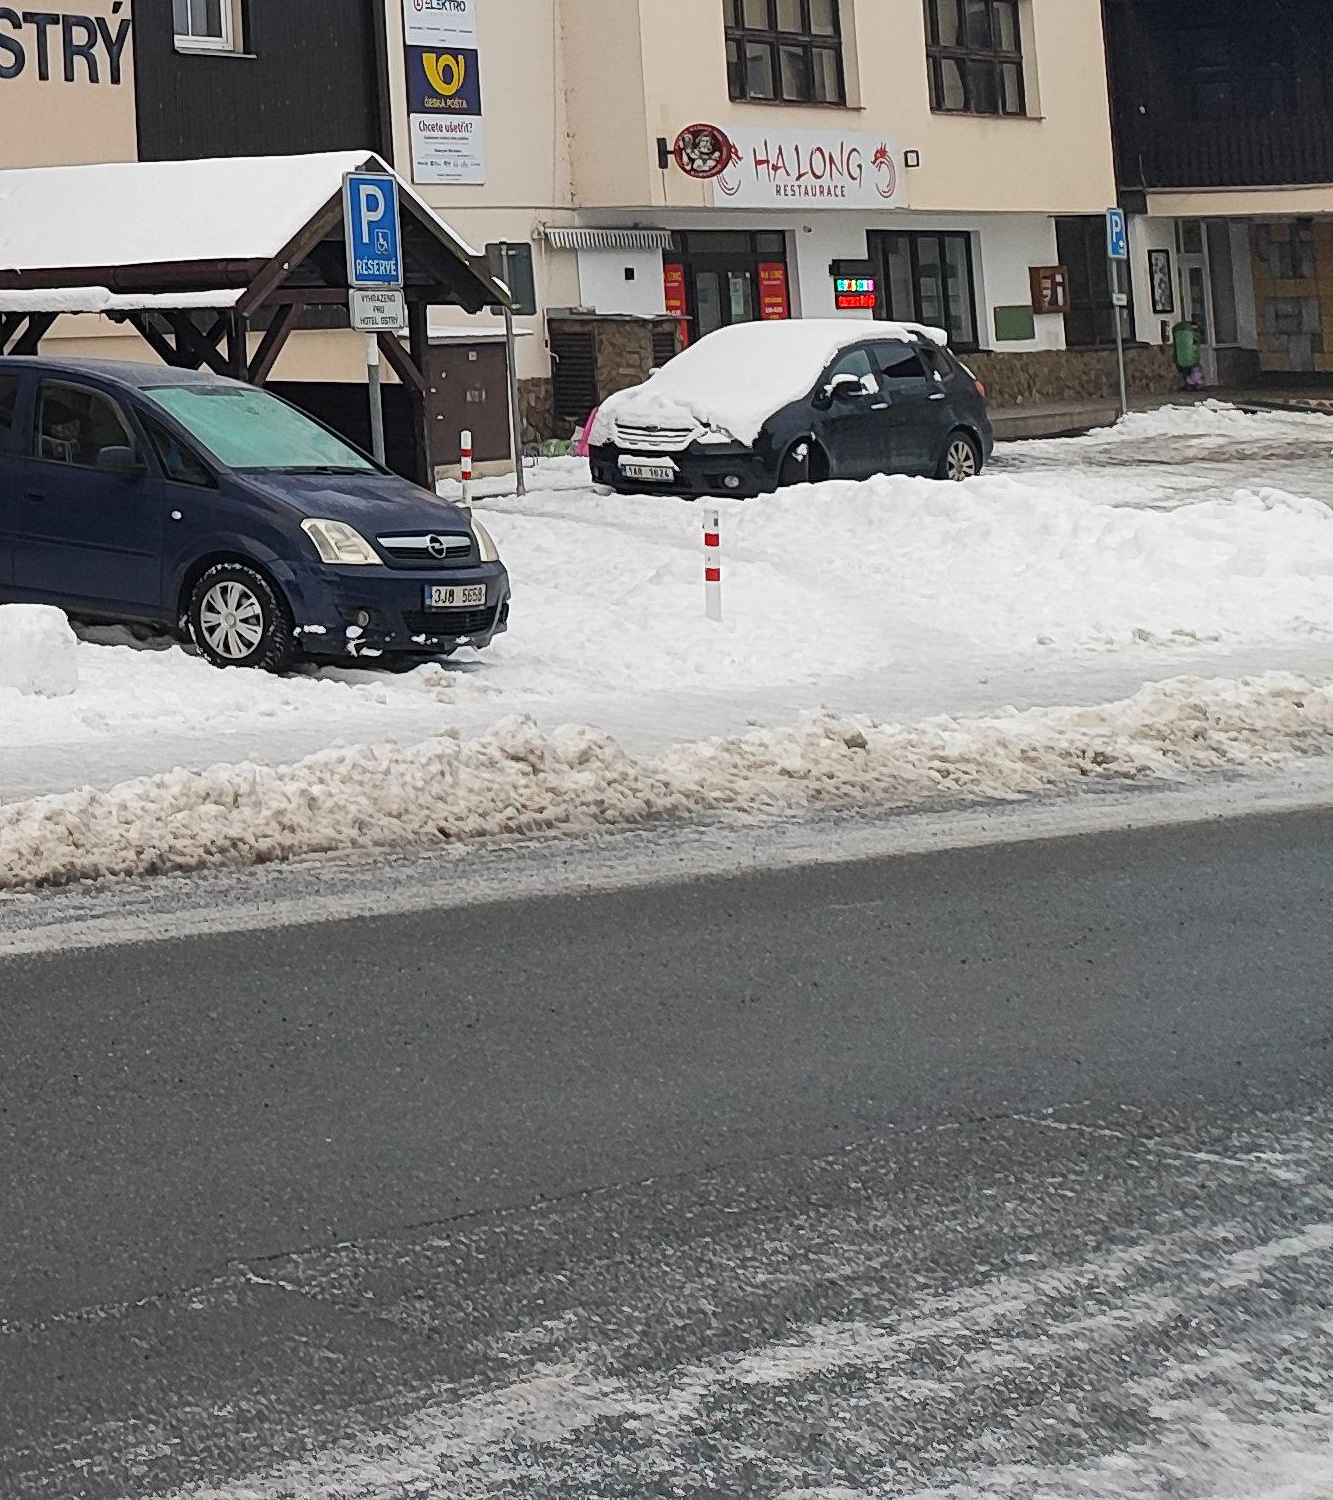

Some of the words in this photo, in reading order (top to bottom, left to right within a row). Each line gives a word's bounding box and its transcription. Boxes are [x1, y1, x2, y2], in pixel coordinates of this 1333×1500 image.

[418, 119, 444, 133] Chcete
[776, 184, 846, 198] RESTAURACE
[359, 184, 385, 244] P
[356, 256, 397, 276] RÉSERVÉ
